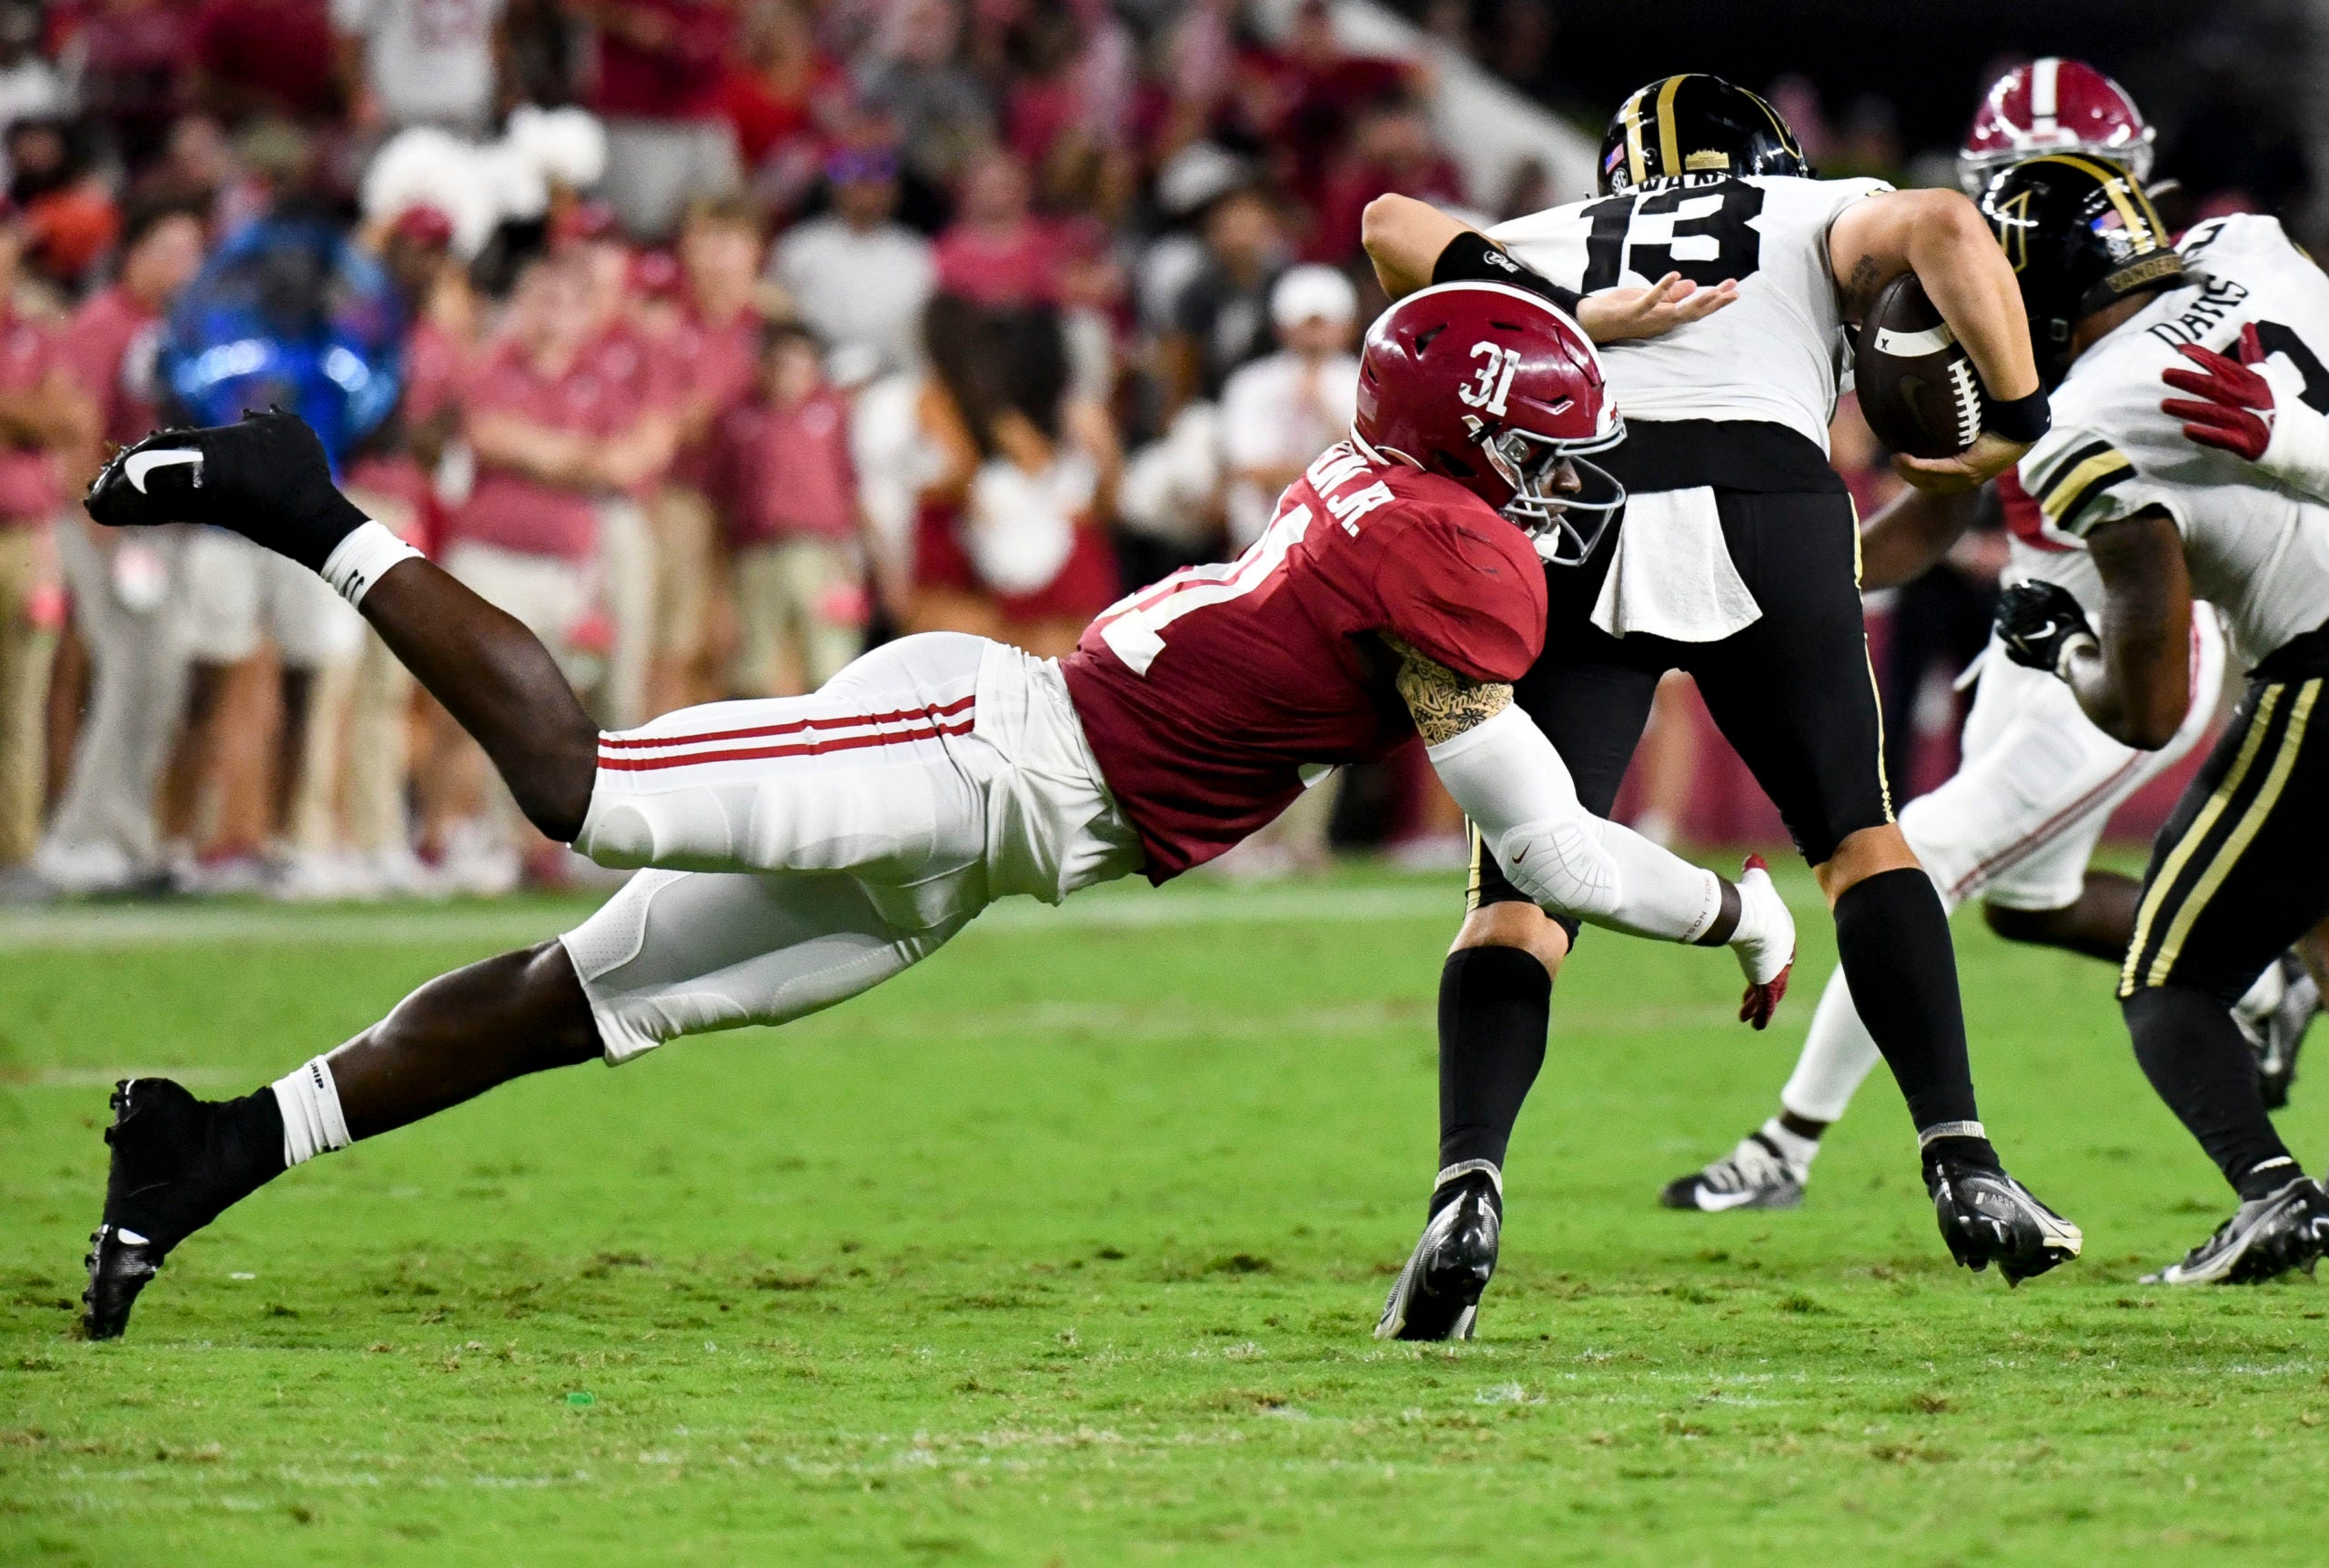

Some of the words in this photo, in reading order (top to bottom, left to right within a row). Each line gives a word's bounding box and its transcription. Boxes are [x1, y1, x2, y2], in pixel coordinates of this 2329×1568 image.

[1579, 177, 1765, 295] 13
[2147, 275, 2249, 353] DAVIS
[1458, 340, 1521, 417] 31
[1326, 479, 1396, 538] JR.
